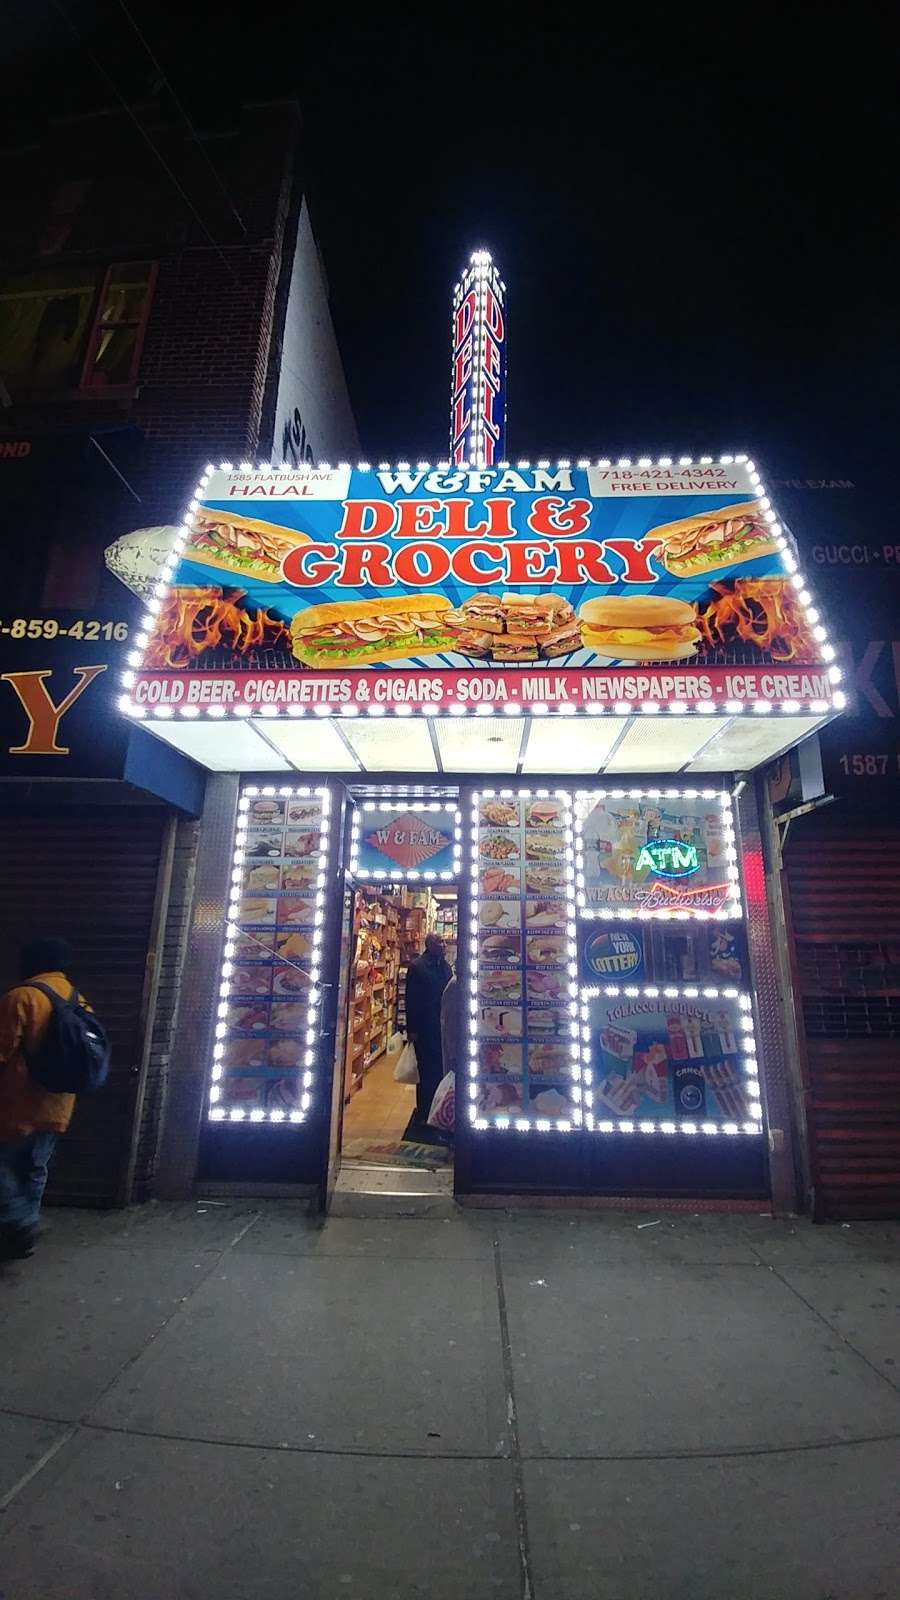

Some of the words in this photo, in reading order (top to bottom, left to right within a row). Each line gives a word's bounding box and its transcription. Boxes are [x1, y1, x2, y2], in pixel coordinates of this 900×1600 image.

[0, 441, 32, 458] ND
[254, 473, 310, 481] FLATBUSH
[311, 473, 333, 481] AVE
[376, 469, 575, 495] W&FAM
[600, 468, 727, 481] 718-421-4342
[229, 485, 314, 496] HALAL
[611, 482, 652, 492] FREE
[656, 480, 738, 491] DELIVERY
[338, 500, 515, 539] DELI
[528, 497, 592, 537] &
[283, 540, 662, 586] GROCERY
[812, 545, 870, 565] GUCCI
[0, 619, 128, 641] -859-4216
[136, 680, 184, 703] COLD
[244, 679, 351, 701] CIGARETTES
[356, 679, 371, 700] &
[373, 678, 443, 701] CIGARS
[456, 678, 508, 701] SODA
[521, 677, 568, 700] MILK
[582, 676, 712, 699] NEWSPAPERS
[726, 675, 756, 698] ICE
[761, 674, 832, 698] CREAM
[840, 754, 888, 776] 1587
[376, 830, 389, 845] W
[394, 830, 405, 846] &
[409, 830, 441, 847] FAM
[636, 847, 698, 871] ATM
[613, 941, 636, 954] YORK
[591, 951, 638, 973] LOTTERY
[606, 1001, 656, 1022] TOBACCO
